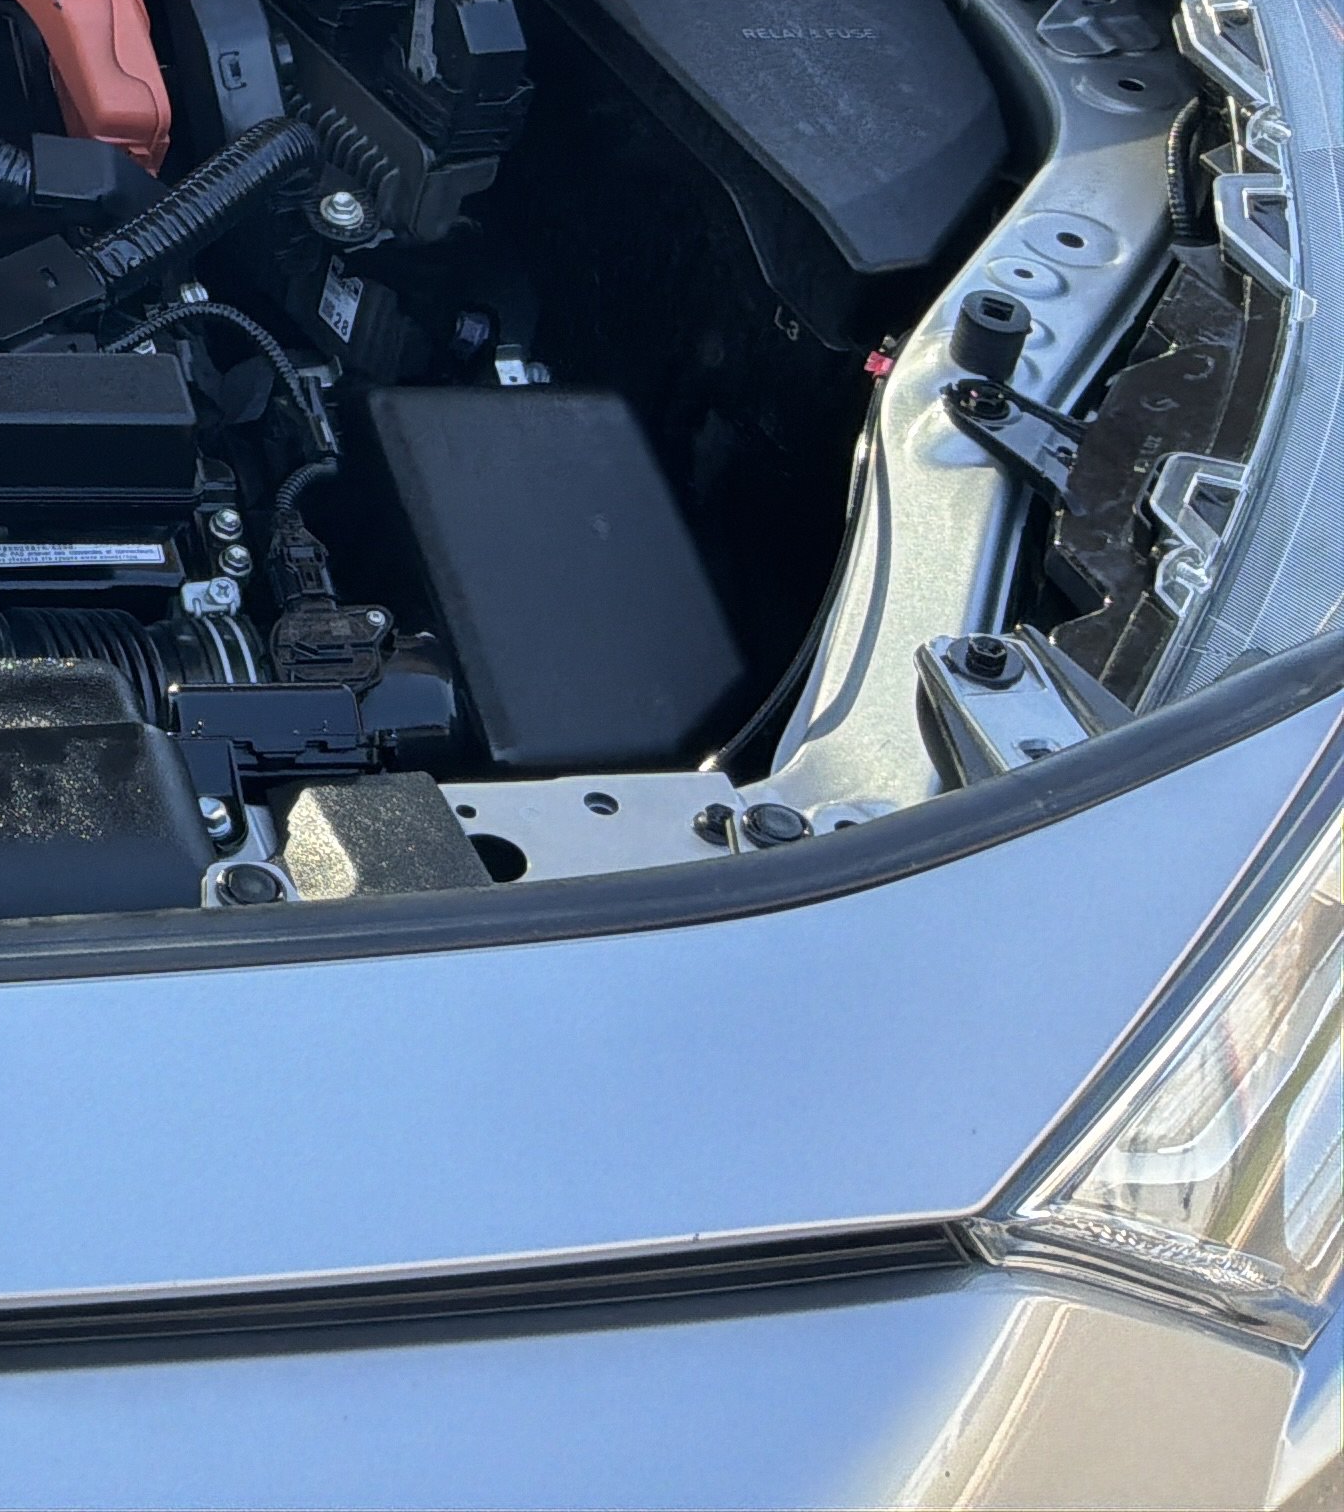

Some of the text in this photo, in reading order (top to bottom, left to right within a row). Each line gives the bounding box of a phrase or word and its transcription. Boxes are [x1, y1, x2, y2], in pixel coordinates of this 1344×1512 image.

[742, 28, 802, 39] RELAY
[825, 28, 876, 39] FUSE
[333, 311, 349, 336] 28
[774, 305, 799, 341] L3
